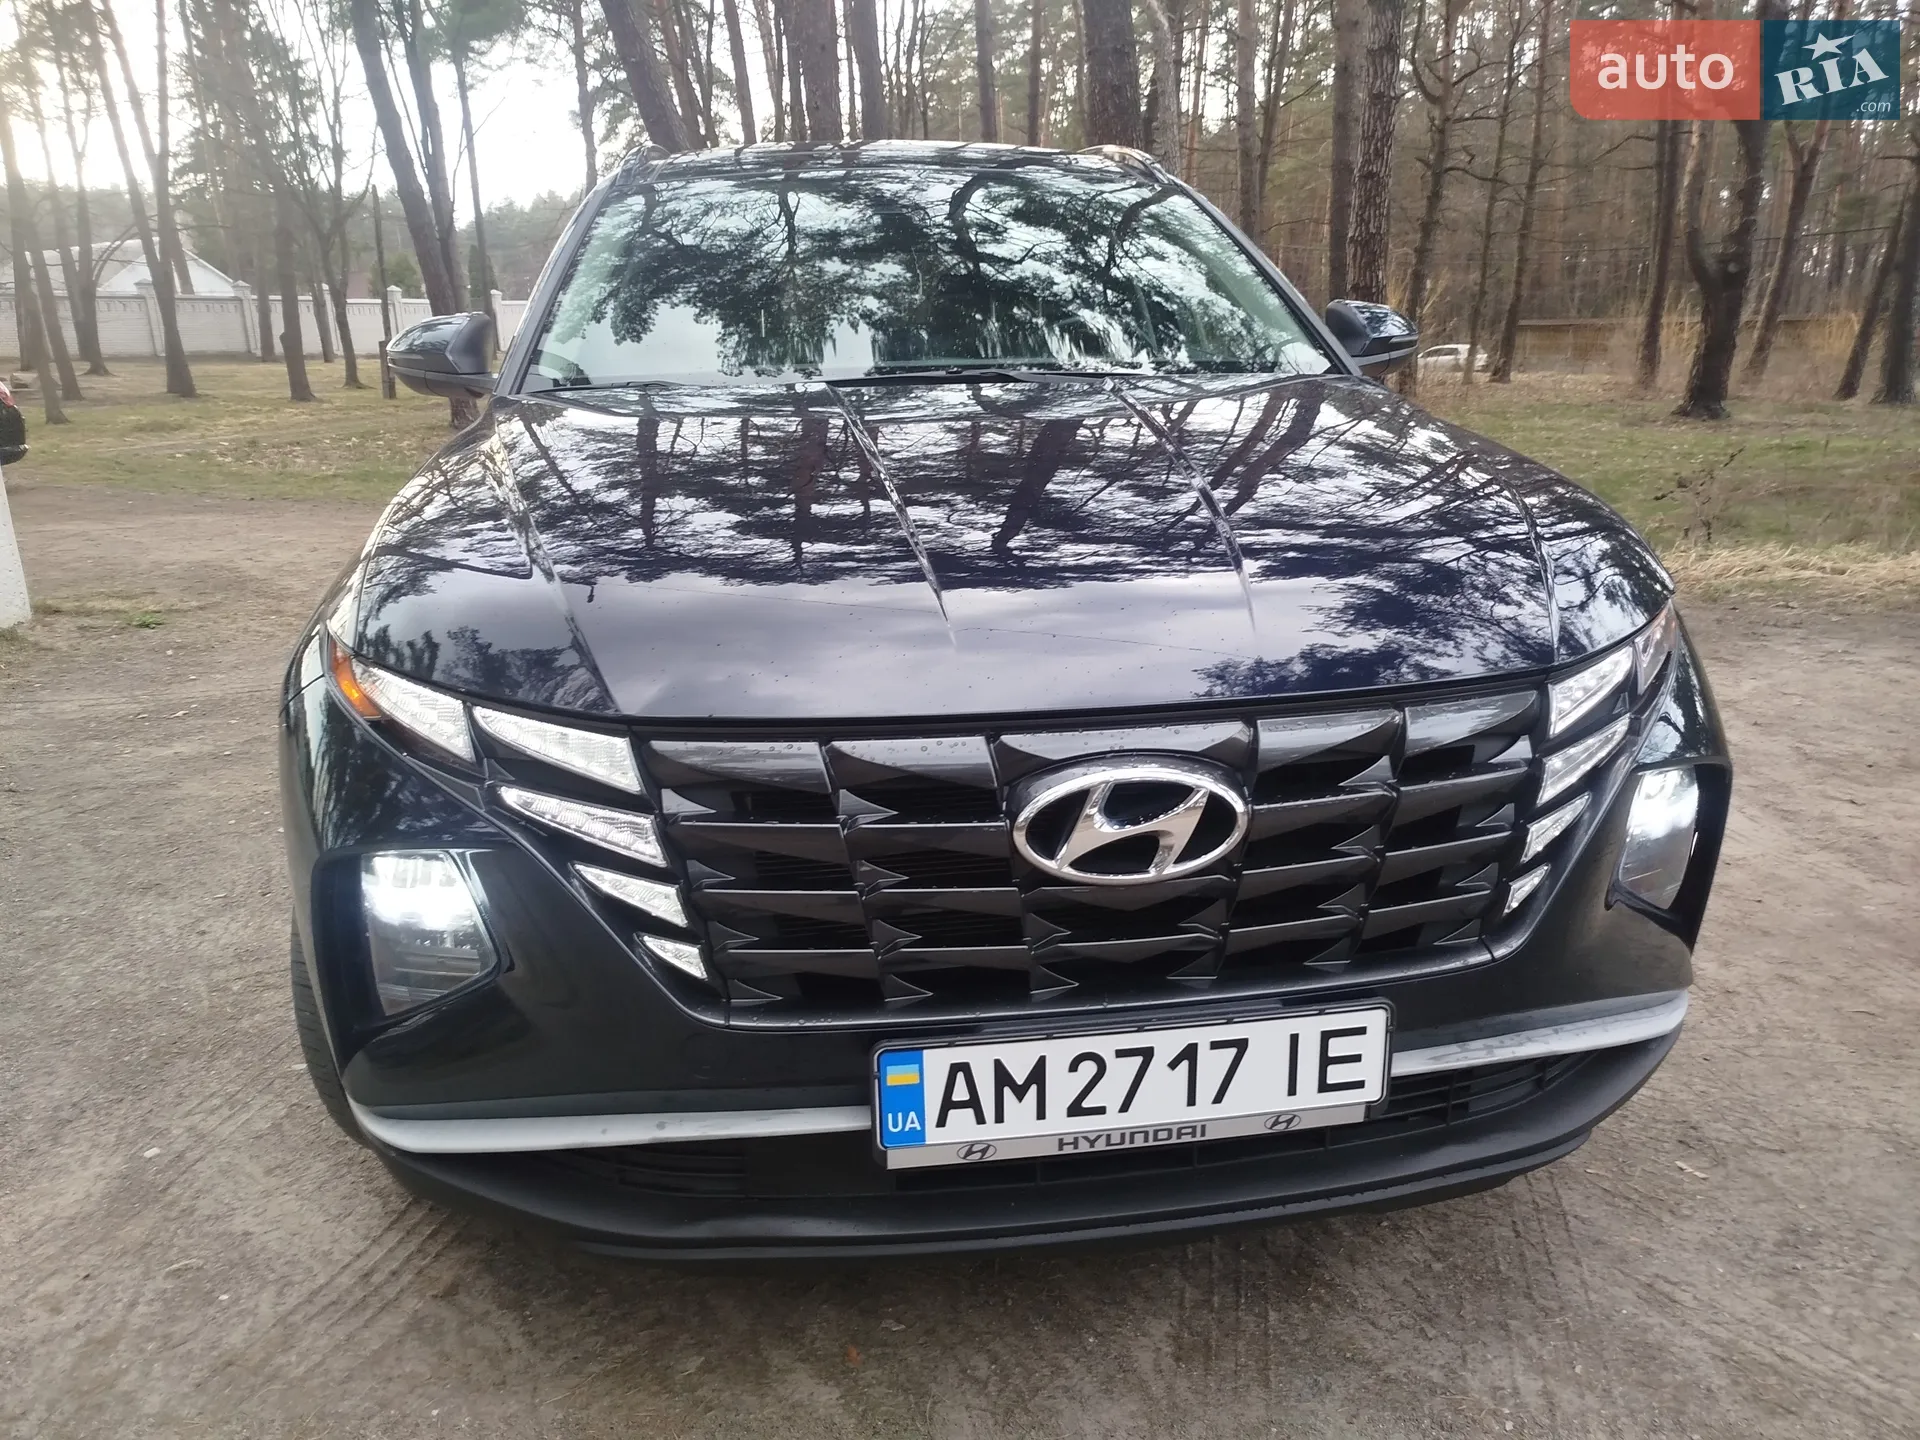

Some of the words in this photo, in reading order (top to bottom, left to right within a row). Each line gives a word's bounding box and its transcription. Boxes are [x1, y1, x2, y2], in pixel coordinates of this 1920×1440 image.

[935, 1054, 1047, 1129] AM
[1066, 1037, 1249, 1118] 2717
[1286, 1026, 1368, 1097] IE
[887, 1110, 922, 1133] UA
[1057, 1123, 1207, 1152] HYUNDAI
